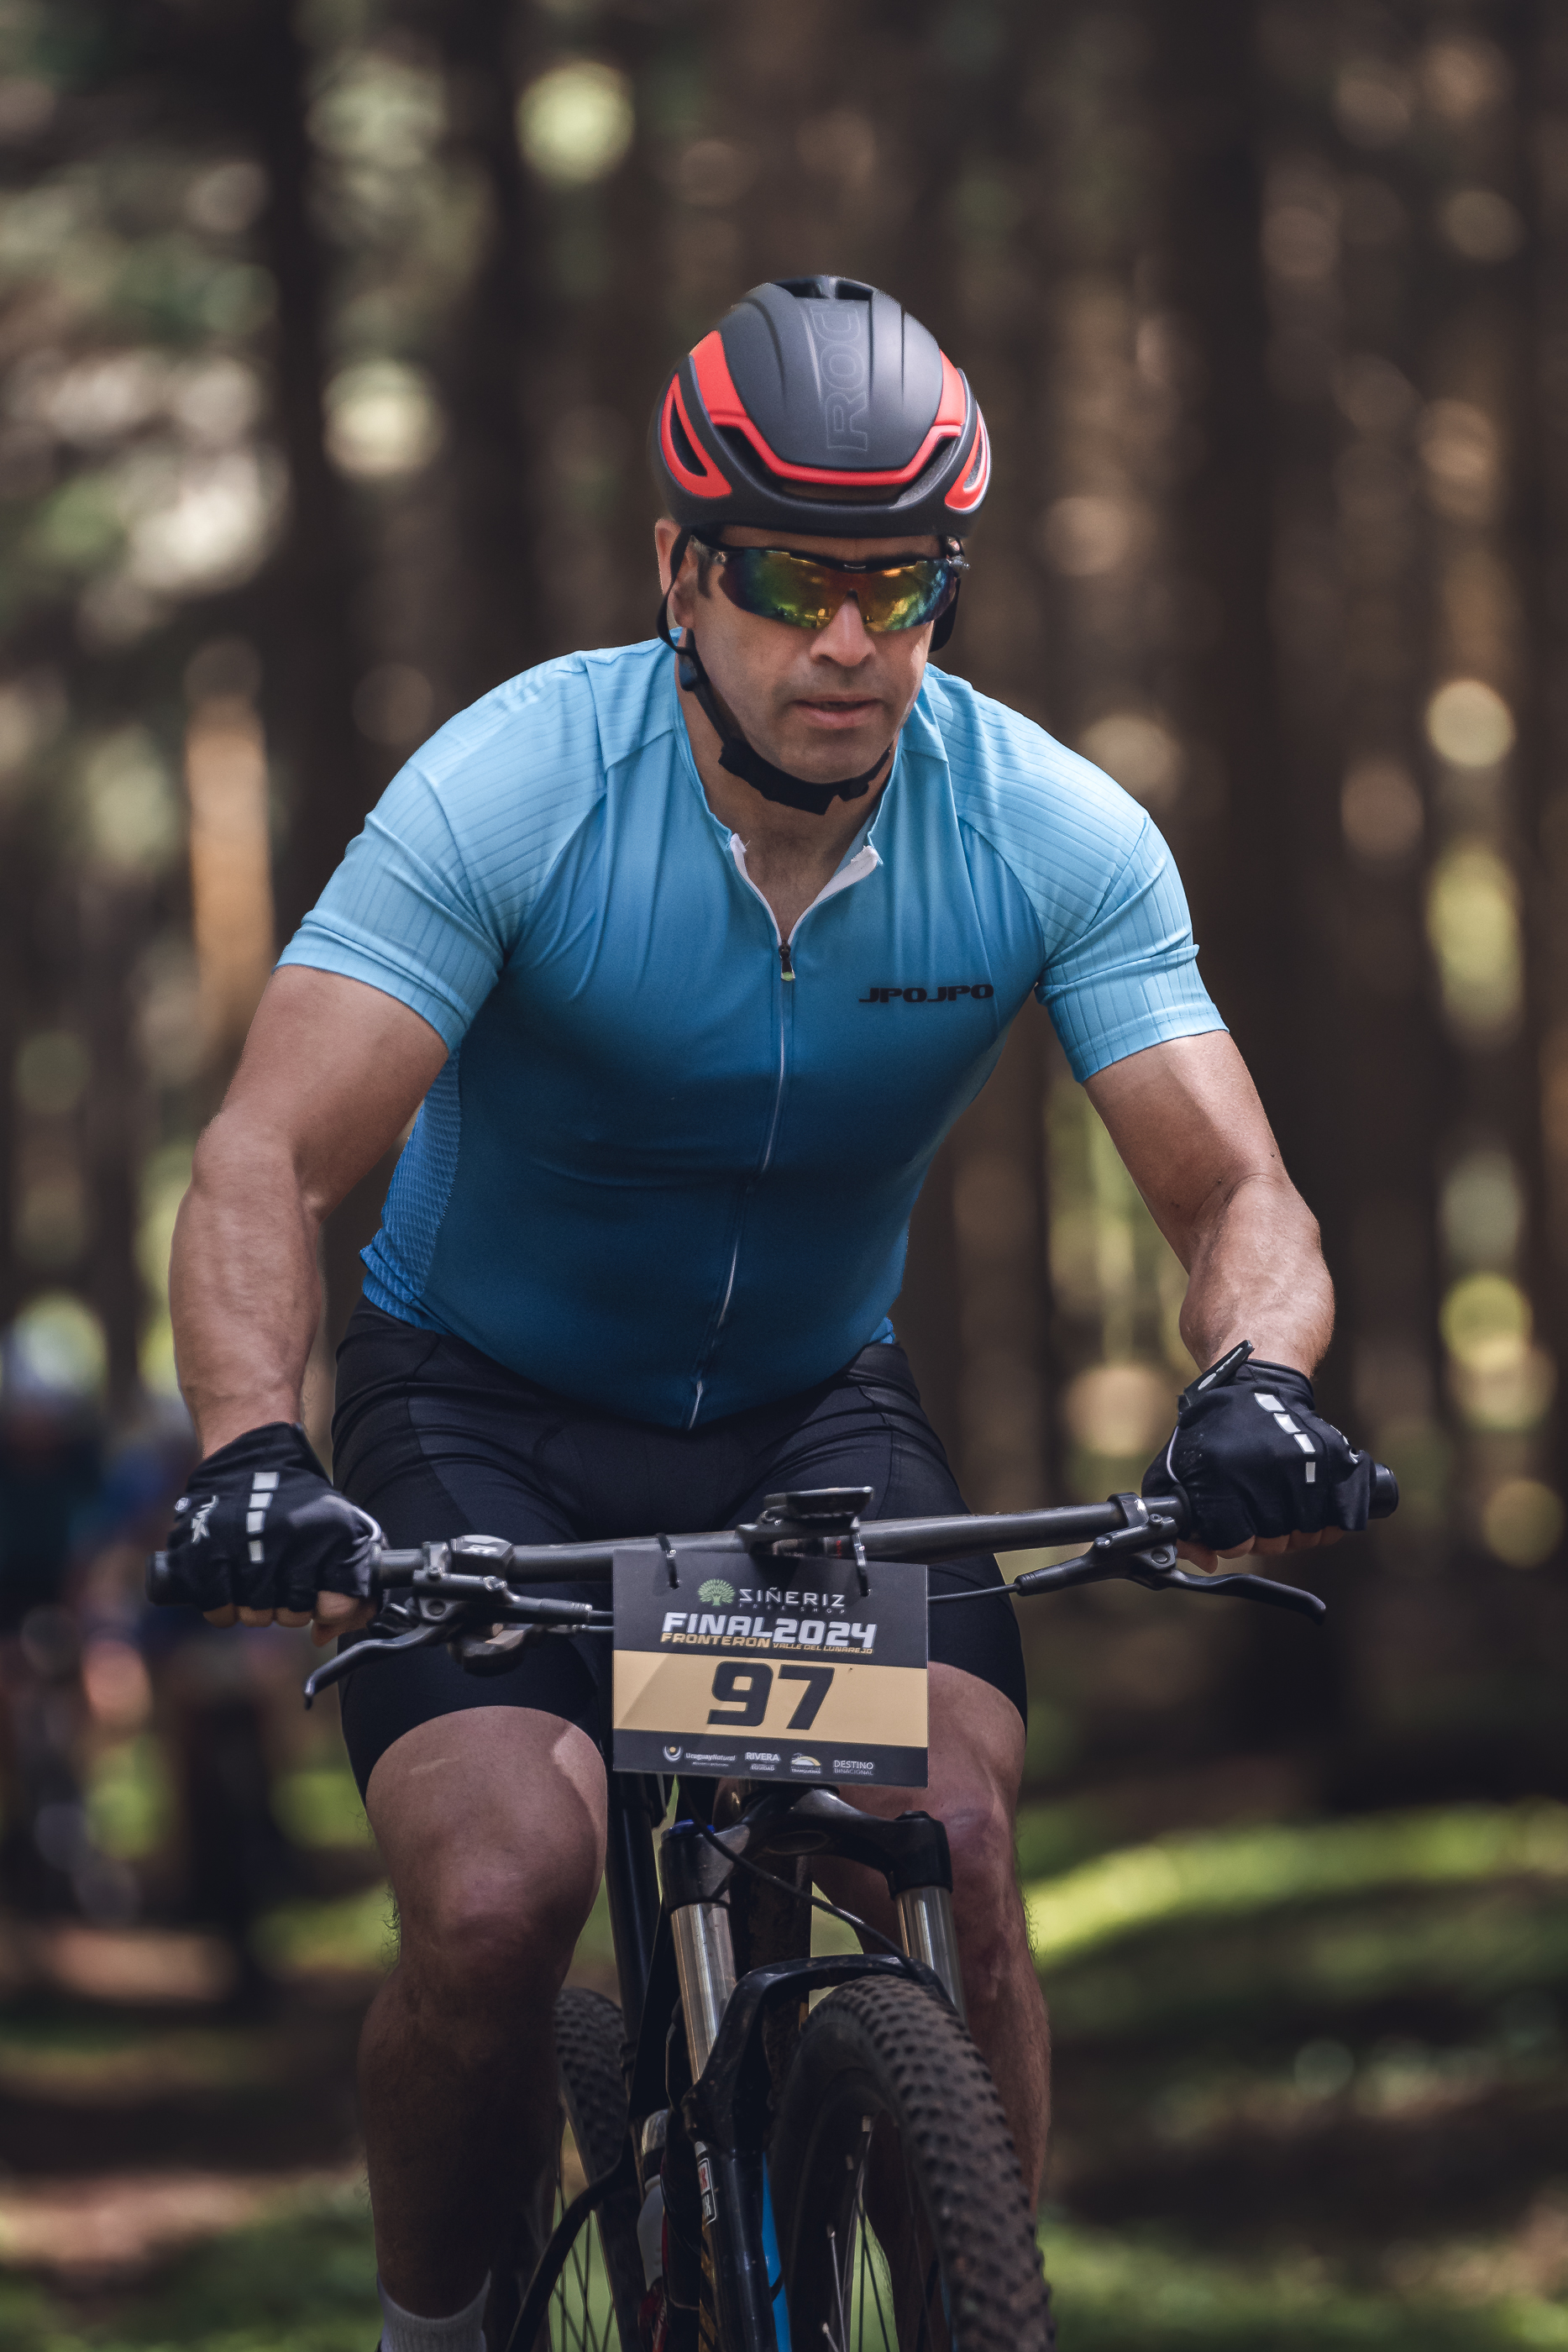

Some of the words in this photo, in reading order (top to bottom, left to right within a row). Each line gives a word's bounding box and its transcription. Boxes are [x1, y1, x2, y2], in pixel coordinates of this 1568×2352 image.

[858, 984, 994, 1004] JPOJPO
[738, 1587, 845, 1608] SIÑERIZ
[738, 1603, 785, 1611] FREE
[660, 1632, 771, 1648] FRONTERON
[823, 1645, 873, 1655] LUNAREJO
[706, 1660, 836, 1730] 97
[746, 1751, 780, 1761] RIVERA
[834, 1760, 874, 1770] DESTINO
[834, 1767, 873, 1776] BINACIONAL
